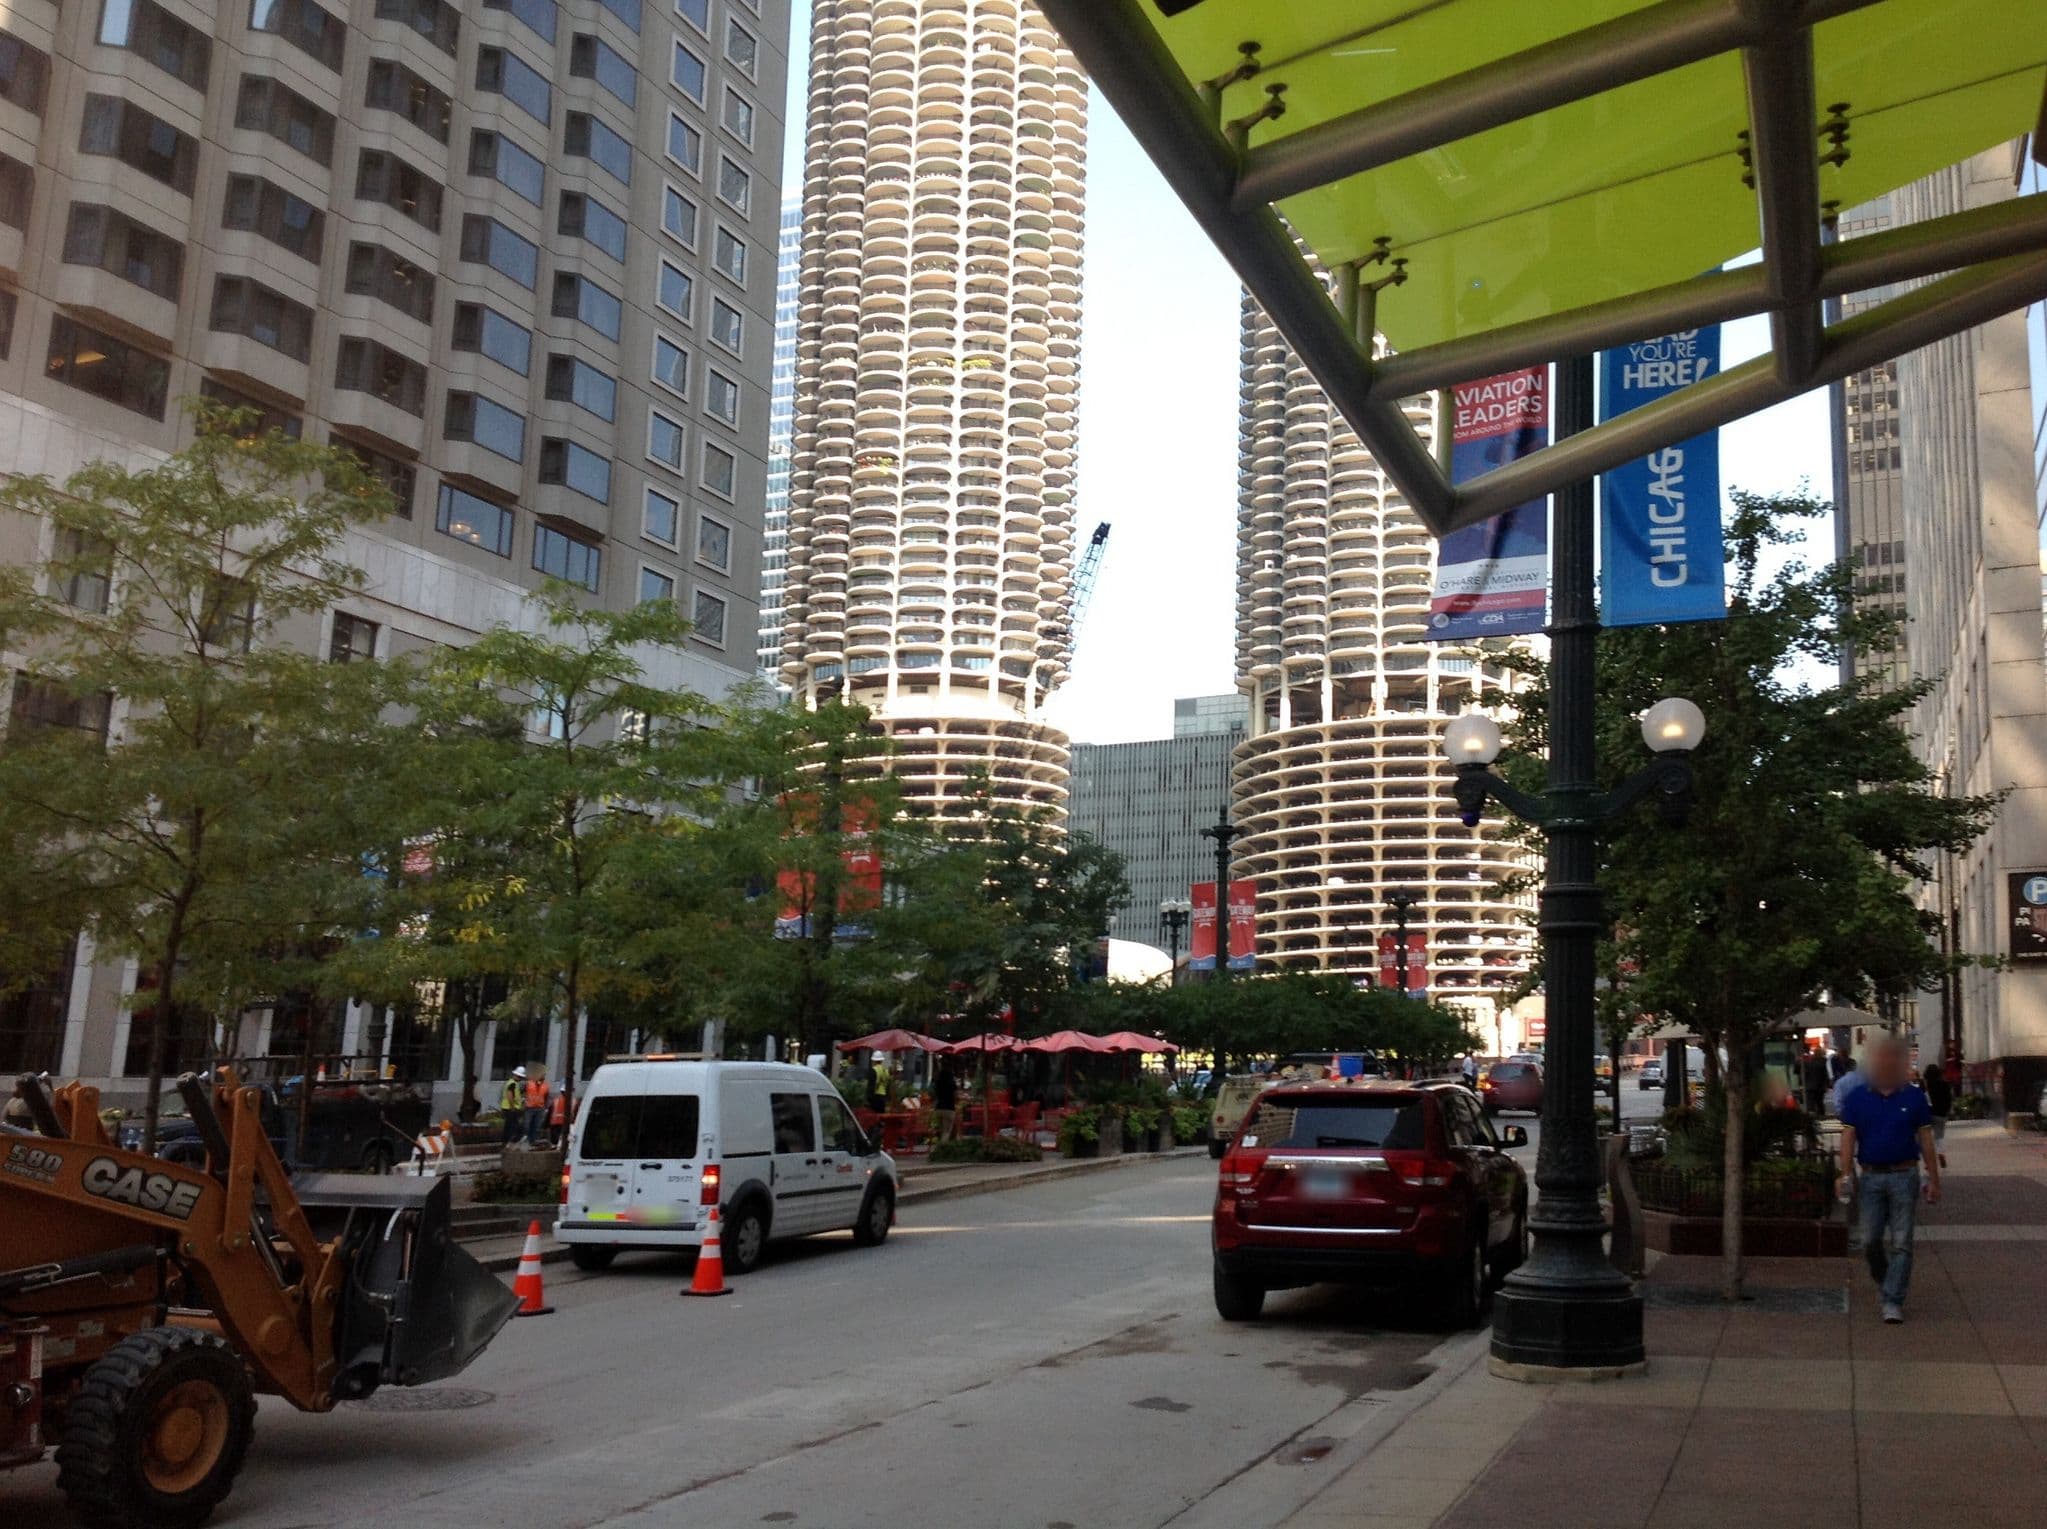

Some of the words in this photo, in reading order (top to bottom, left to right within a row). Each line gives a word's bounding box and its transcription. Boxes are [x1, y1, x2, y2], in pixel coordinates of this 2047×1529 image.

[1628, 340, 1697, 362] YOU'RE
[1454, 395, 1543, 428] EADERS
[1647, 447, 1688, 587] CHICAG
[1492, 572, 1540, 584] MIDWAY
[2032, 879, 2047, 901] P
[82, 1156, 203, 1220] CASE
